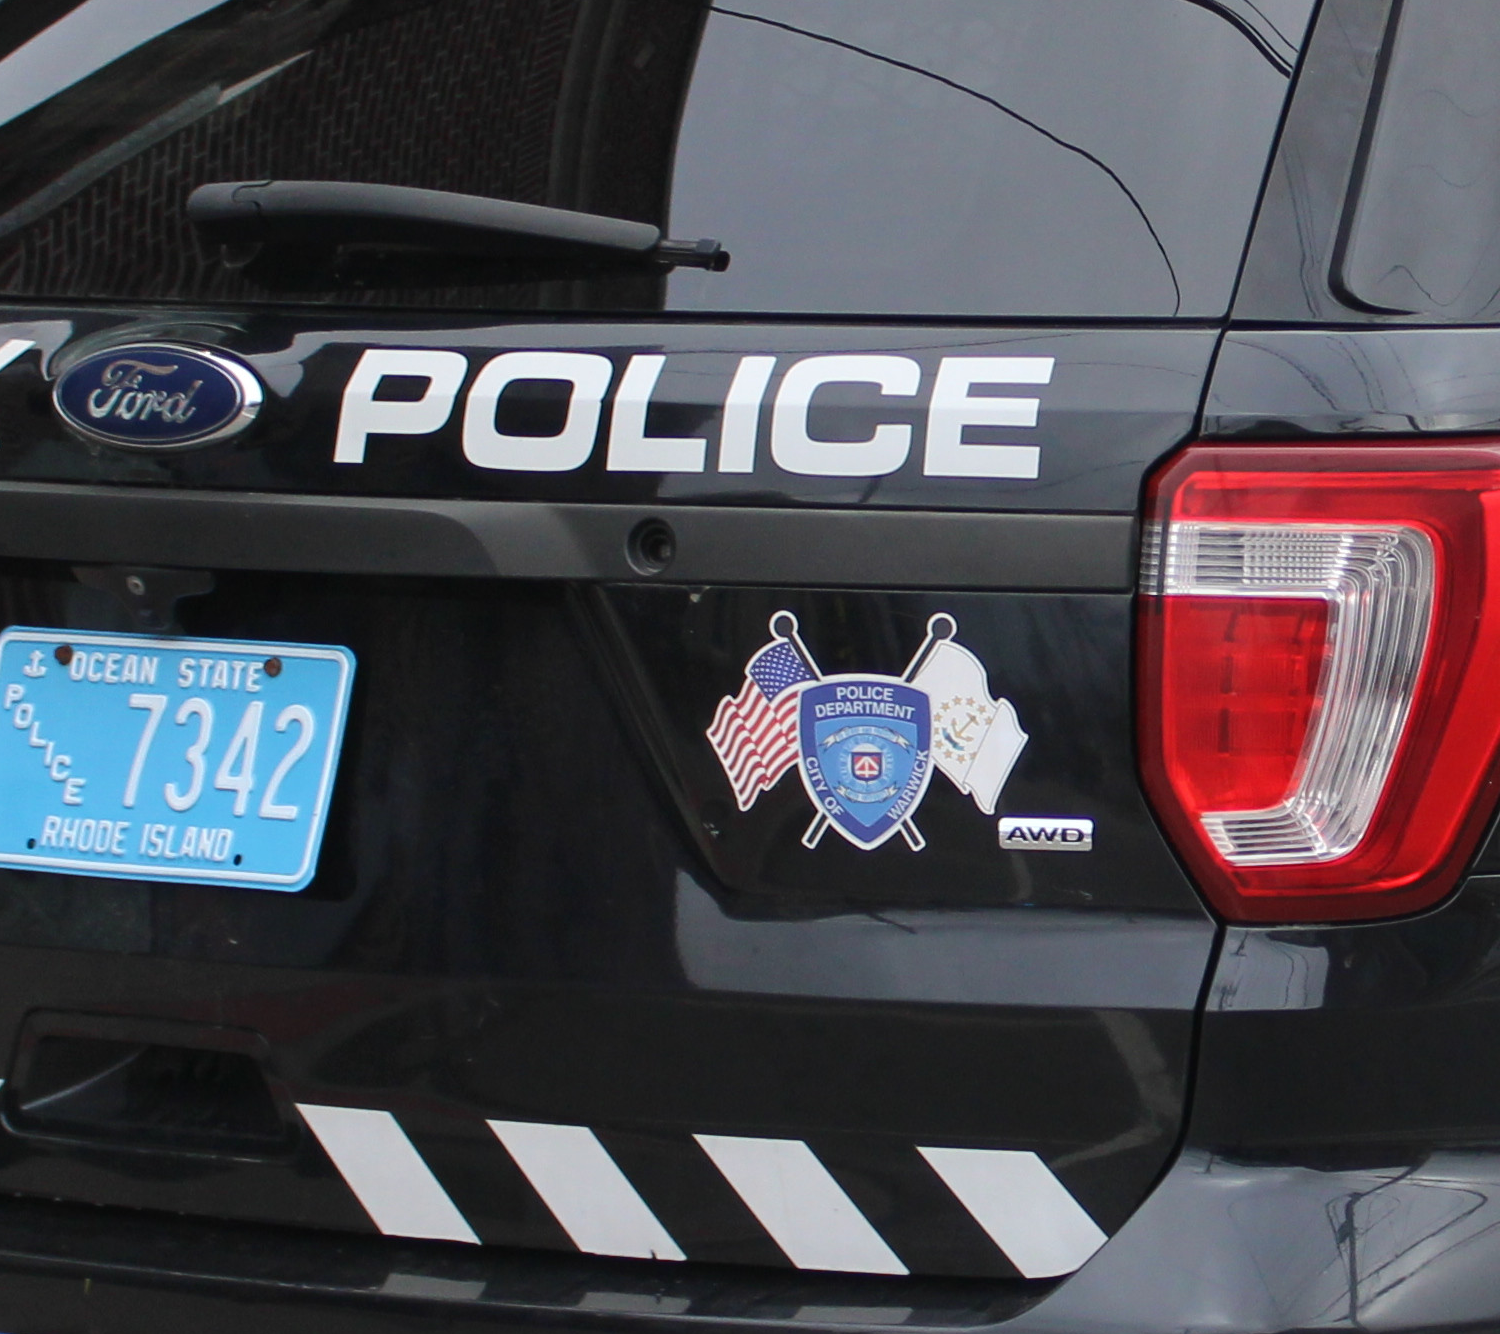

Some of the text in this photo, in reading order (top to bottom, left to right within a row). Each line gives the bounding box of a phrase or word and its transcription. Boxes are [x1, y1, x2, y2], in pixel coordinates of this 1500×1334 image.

[89, 359, 204, 423] Ford
[333, 348, 1056, 479] POLICE
[69, 651, 266, 693] OCEAN STATE
[836, 686, 895, 701] POLICE
[814, 701, 916, 720] DEPARTMENT
[4, 683, 87, 805] POLICE
[122, 693, 316, 821] 7342
[805, 756, 828, 792] CITY
[824, 796, 846, 816] OF
[887, 749, 929, 820] WARWICK
[40, 814, 236, 862] RHODE ISLAND
[1005, 826, 1085, 843] AWD
